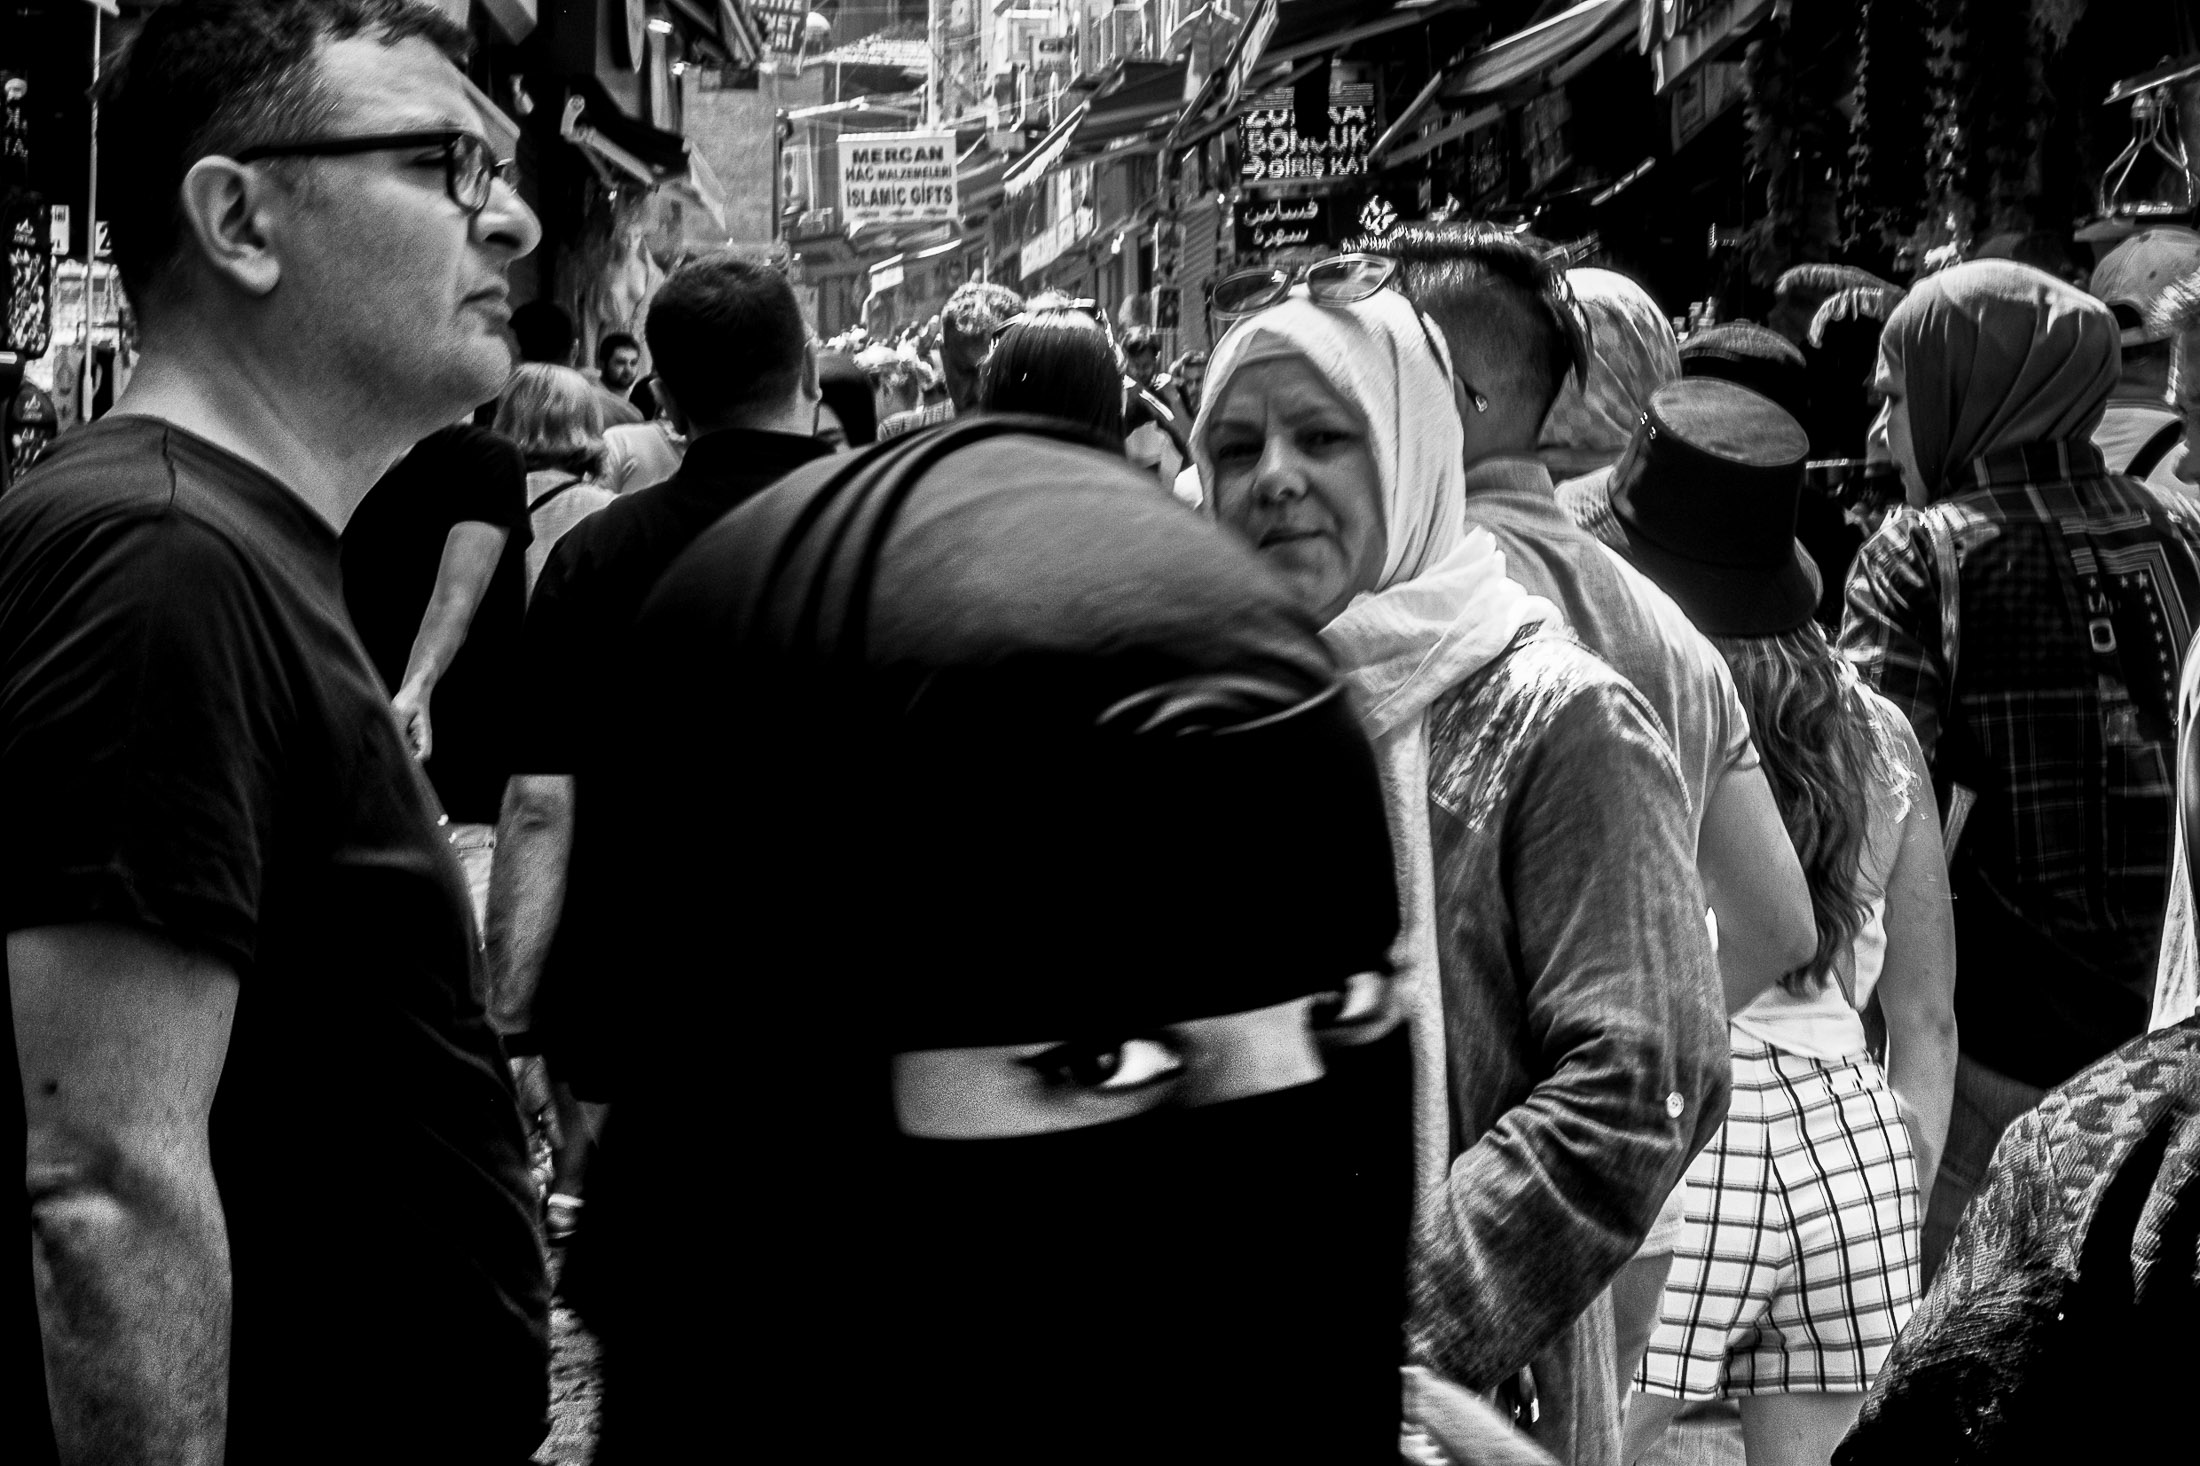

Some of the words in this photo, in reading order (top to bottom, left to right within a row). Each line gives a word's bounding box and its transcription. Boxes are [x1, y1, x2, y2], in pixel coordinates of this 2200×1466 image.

[852, 145, 944, 164] MERCAN
[845, 166, 874, 182] HAC
[1242, 197, 1319, 227] فساتين
